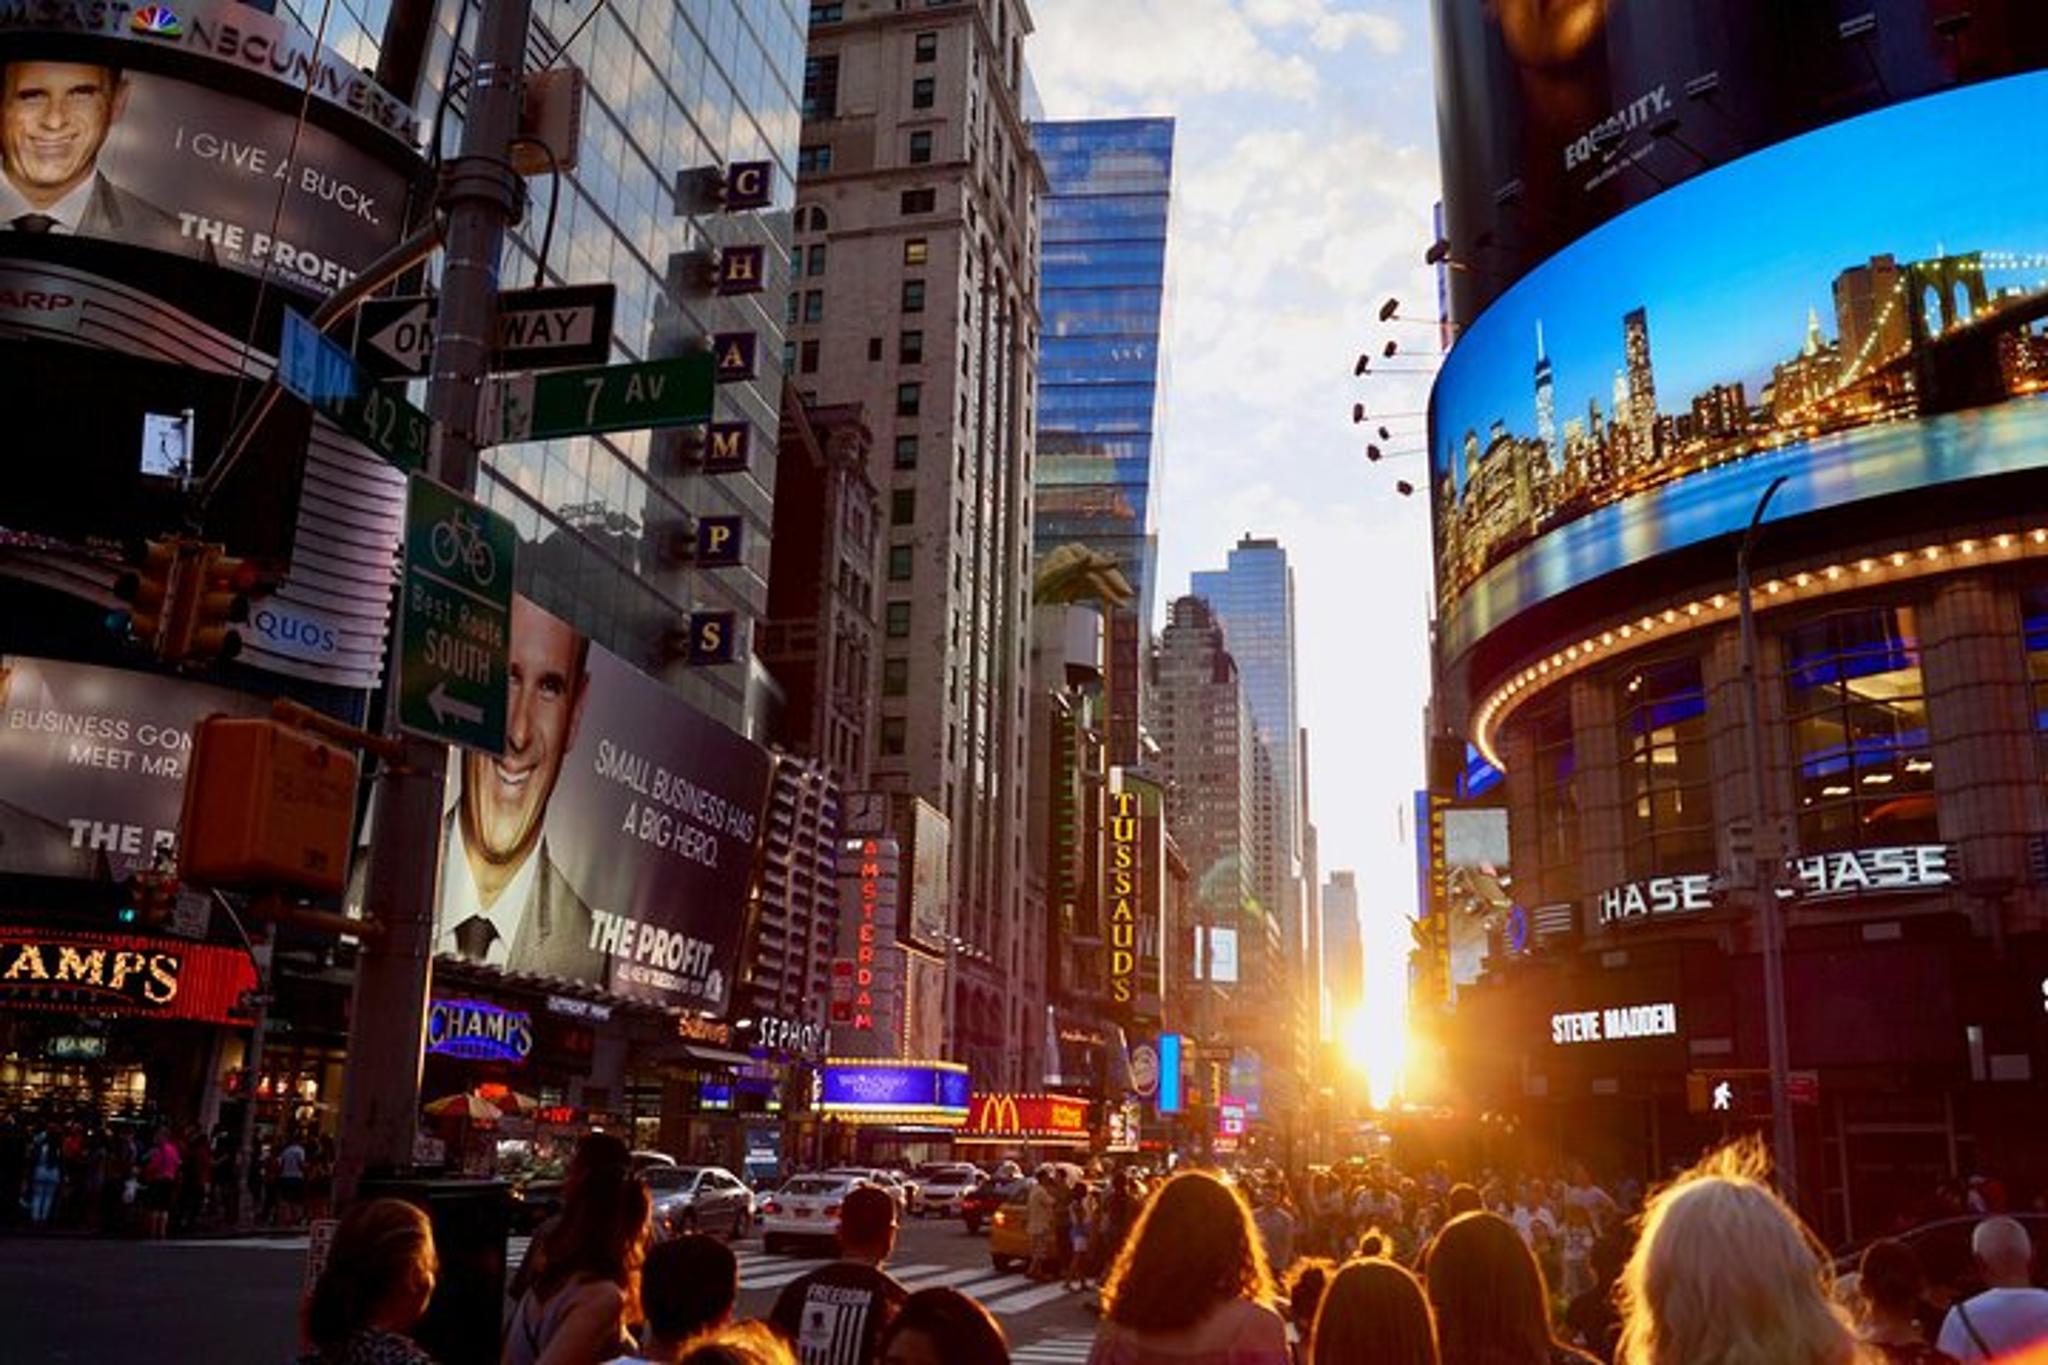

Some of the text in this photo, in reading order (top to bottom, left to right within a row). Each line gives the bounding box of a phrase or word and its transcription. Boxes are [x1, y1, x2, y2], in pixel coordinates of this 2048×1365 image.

[175, 127, 380, 225] I GIVE A BUCK.
[179, 212, 245, 249] THE
[252, 231, 357, 290] PROFI
[394, 310, 578, 354] ON WAY
[363, 386, 396, 453] 42
[582, 376, 605, 426] 7
[247, 610, 334, 652] QUOS
[423, 627, 491, 685] SOUTH
[10, 708, 193, 752] BUSINESS GON
[67, 743, 184, 780] MEET MR.
[594, 739, 757, 844] SMALL BUSINESS HAS
[68, 817, 143, 855] THE
[622, 801, 638, 835] A
[639, 806, 673, 848] BIG
[1112, 792, 1136, 1003] TUSSAUDS
[1598, 874, 1714, 926] HASE
[589, 908, 638, 960] THE
[635, 922, 715, 979] PROFIT
[854, 839, 880, 1031] AMSTERDAM
[429, 1003, 533, 1057] CHAMPS
[1552, 1002, 1677, 1045] STEVE MADDEN
